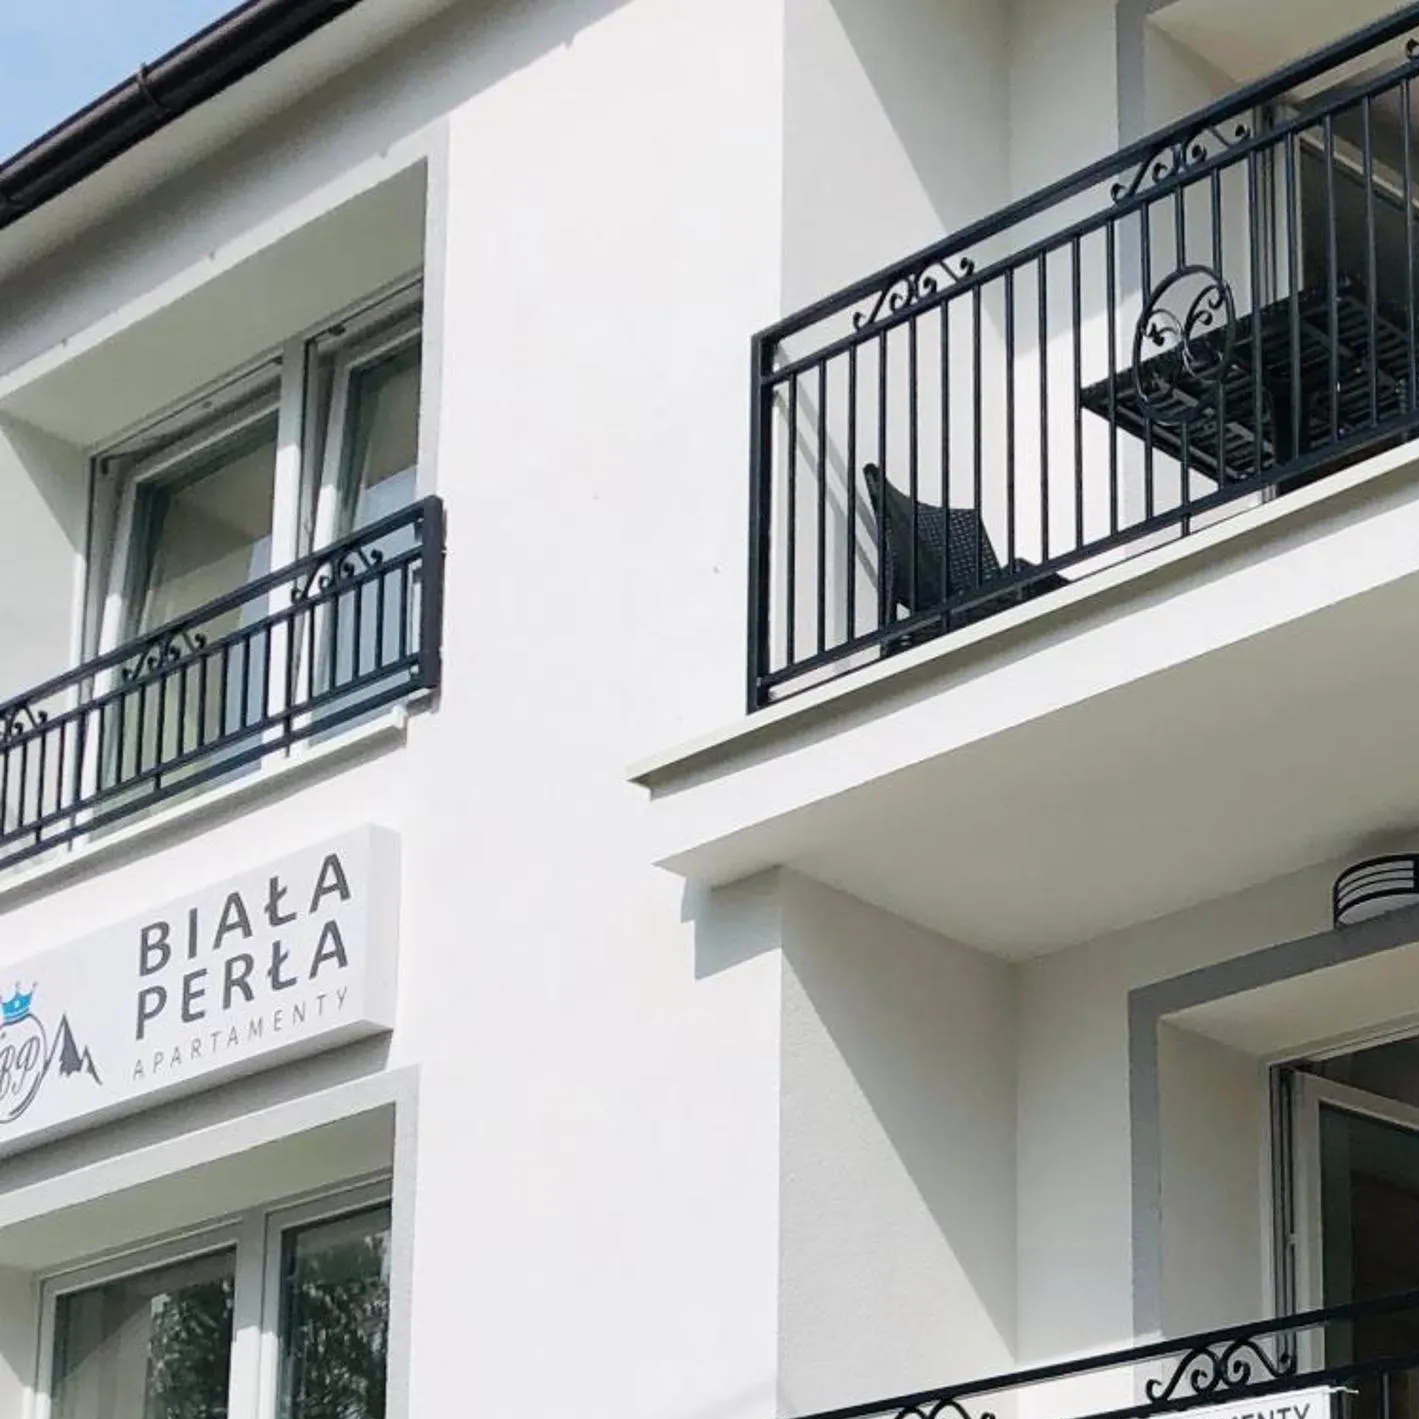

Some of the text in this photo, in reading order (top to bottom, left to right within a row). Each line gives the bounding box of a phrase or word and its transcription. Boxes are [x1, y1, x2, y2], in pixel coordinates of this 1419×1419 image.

[139, 852, 352, 978] BIAŁA
[132, 985, 349, 1081] APARTAMENTY
[135, 919, 349, 1041] PERŁA
